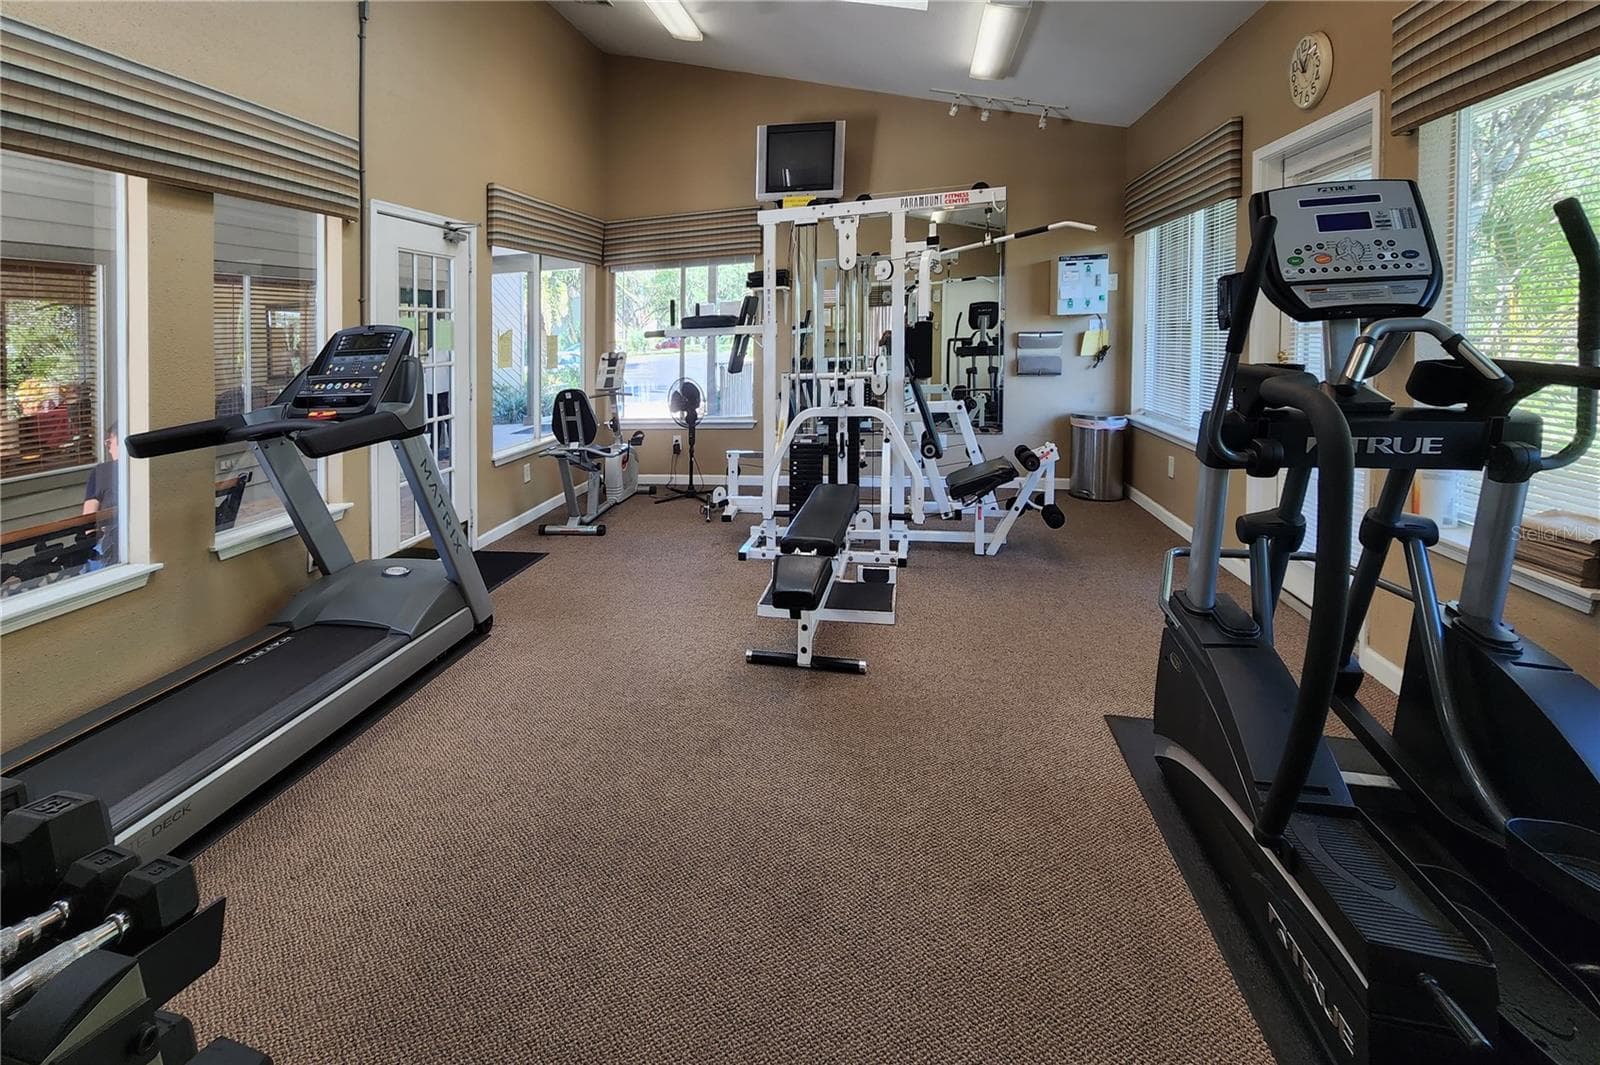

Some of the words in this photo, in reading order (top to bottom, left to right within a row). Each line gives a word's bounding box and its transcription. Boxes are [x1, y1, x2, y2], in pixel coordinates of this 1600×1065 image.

[900, 194, 943, 209] PARAMOUNT
[1350, 436, 1445, 455] TRUE
[420, 458, 462, 554] MATRIX
[151, 803, 192, 837] DECK
